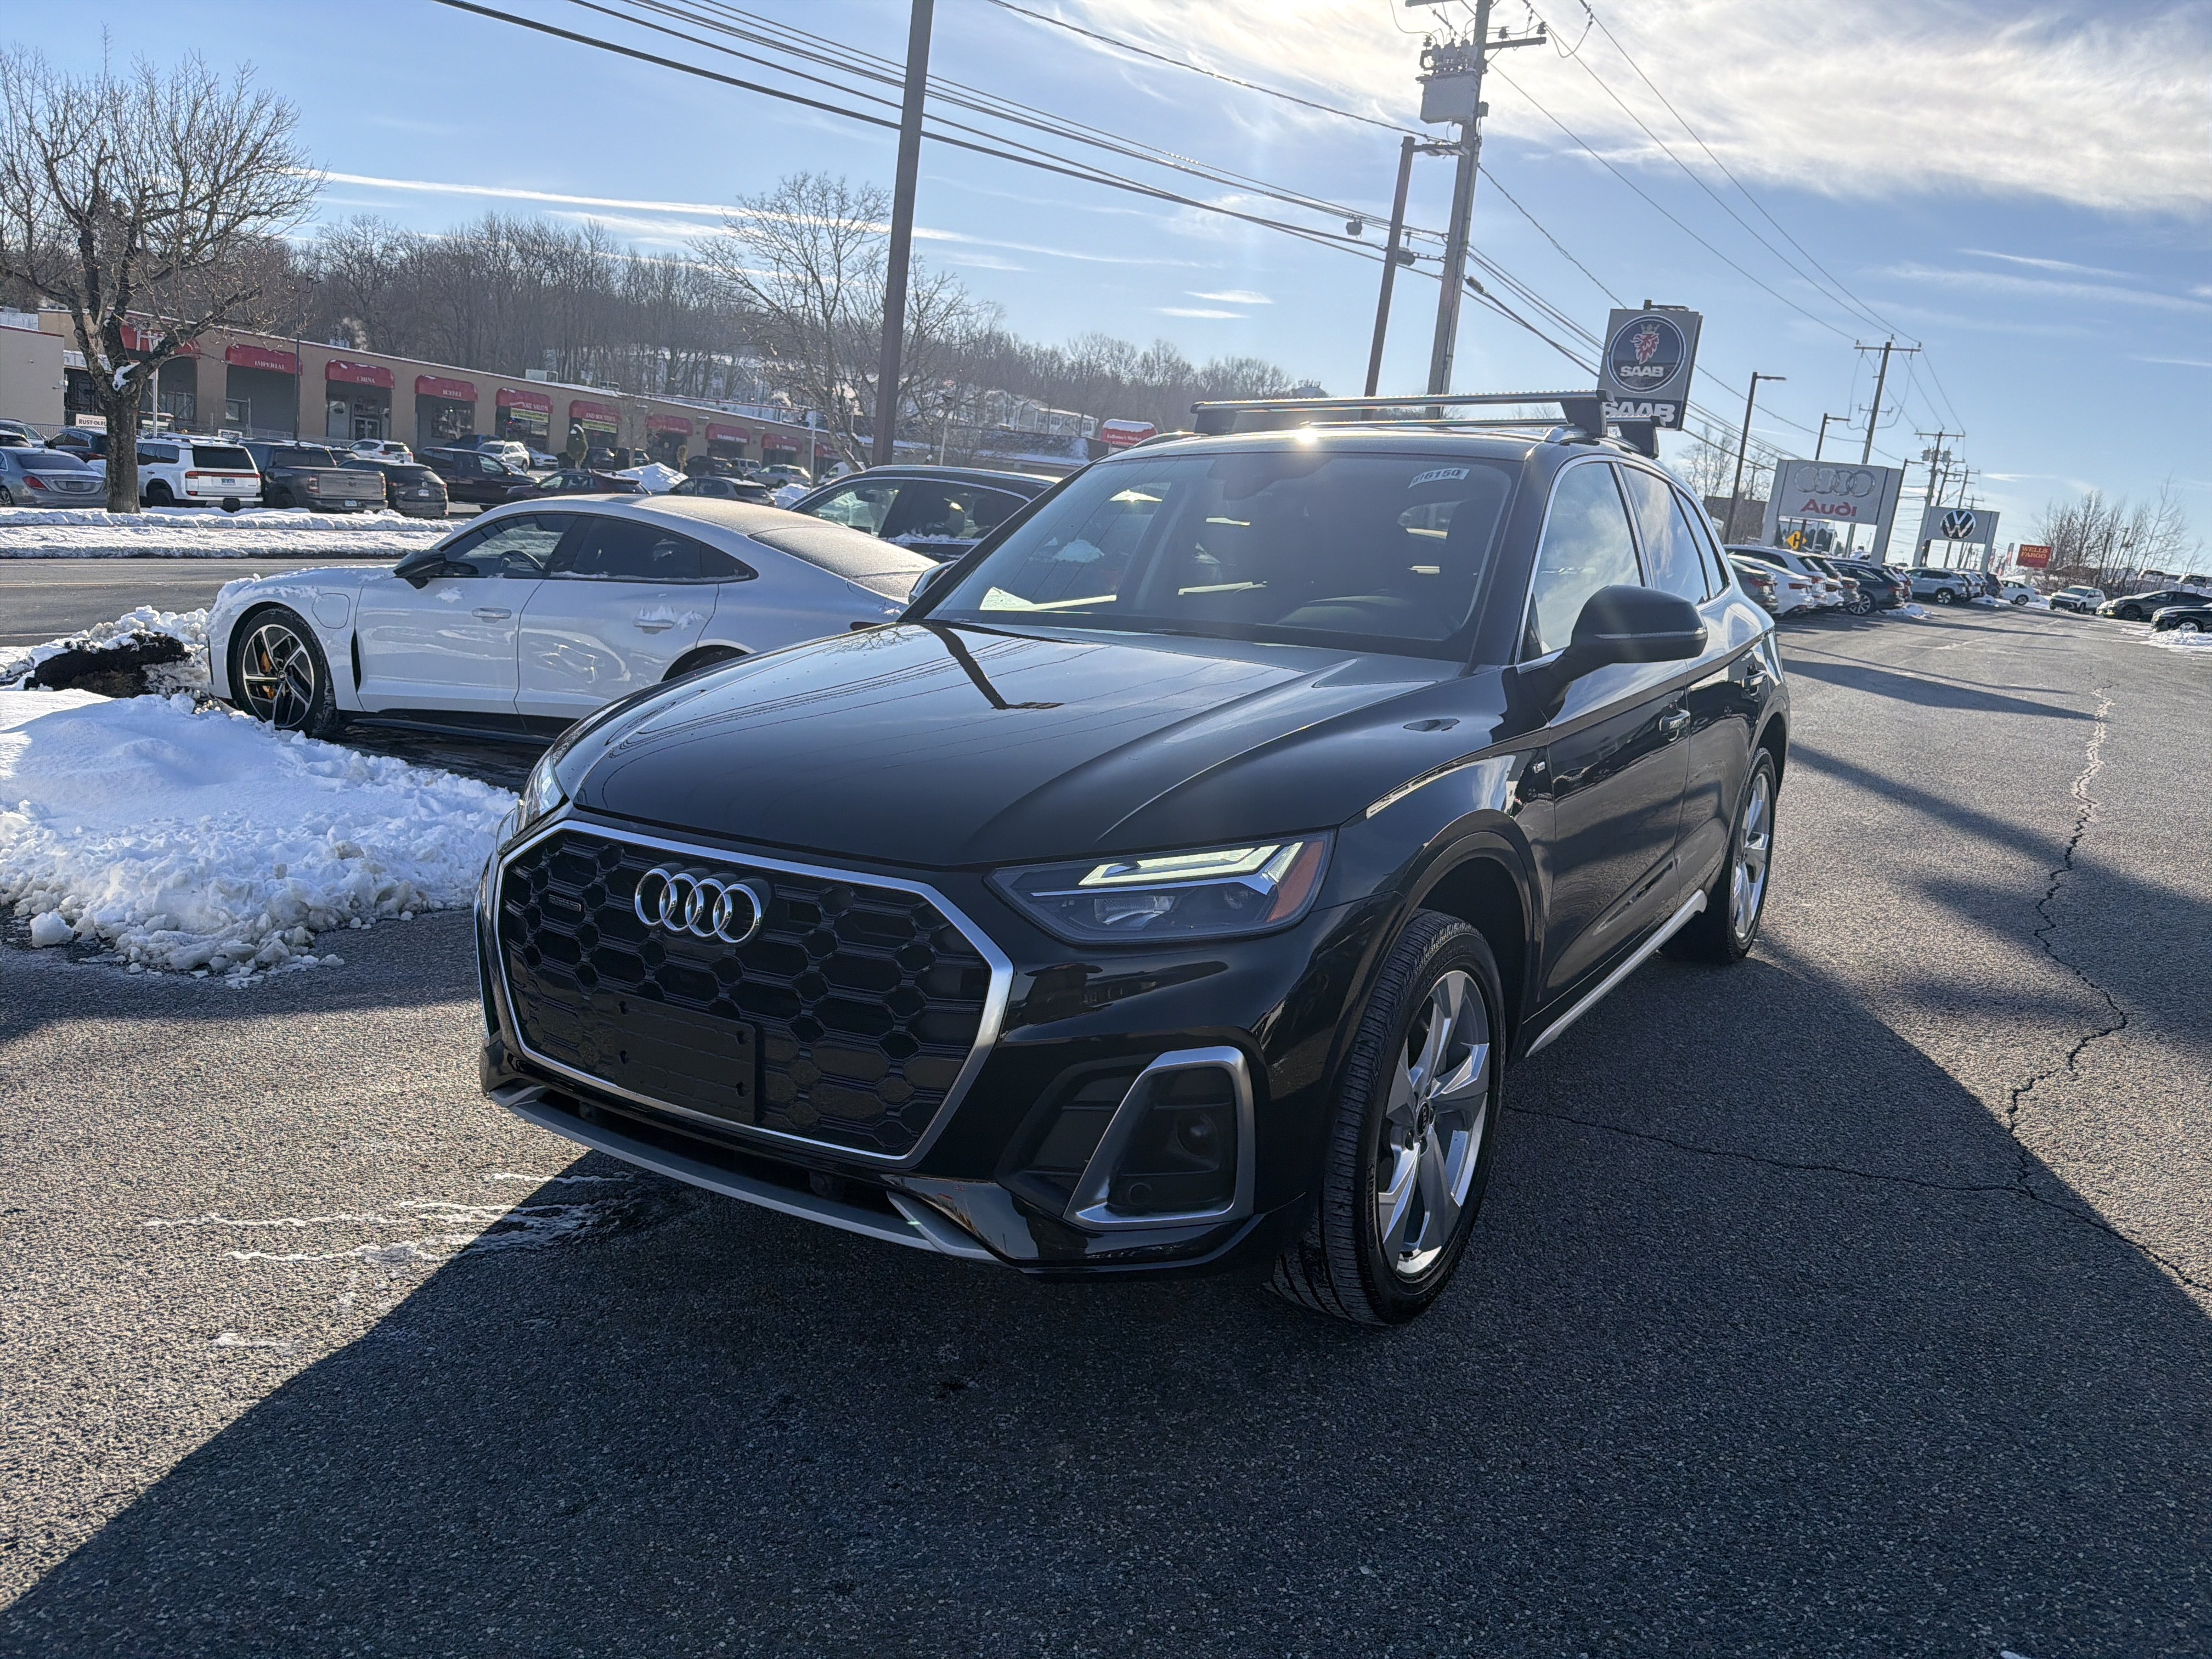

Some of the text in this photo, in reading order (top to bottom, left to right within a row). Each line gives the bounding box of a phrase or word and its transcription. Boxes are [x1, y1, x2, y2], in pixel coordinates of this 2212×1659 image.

[255, 360, 285, 370] IMPERIAL
[1620, 366, 1664, 377] SAAB
[1799, 498, 1858, 517] Audi
[2020, 551, 2047, 559] FARGO
